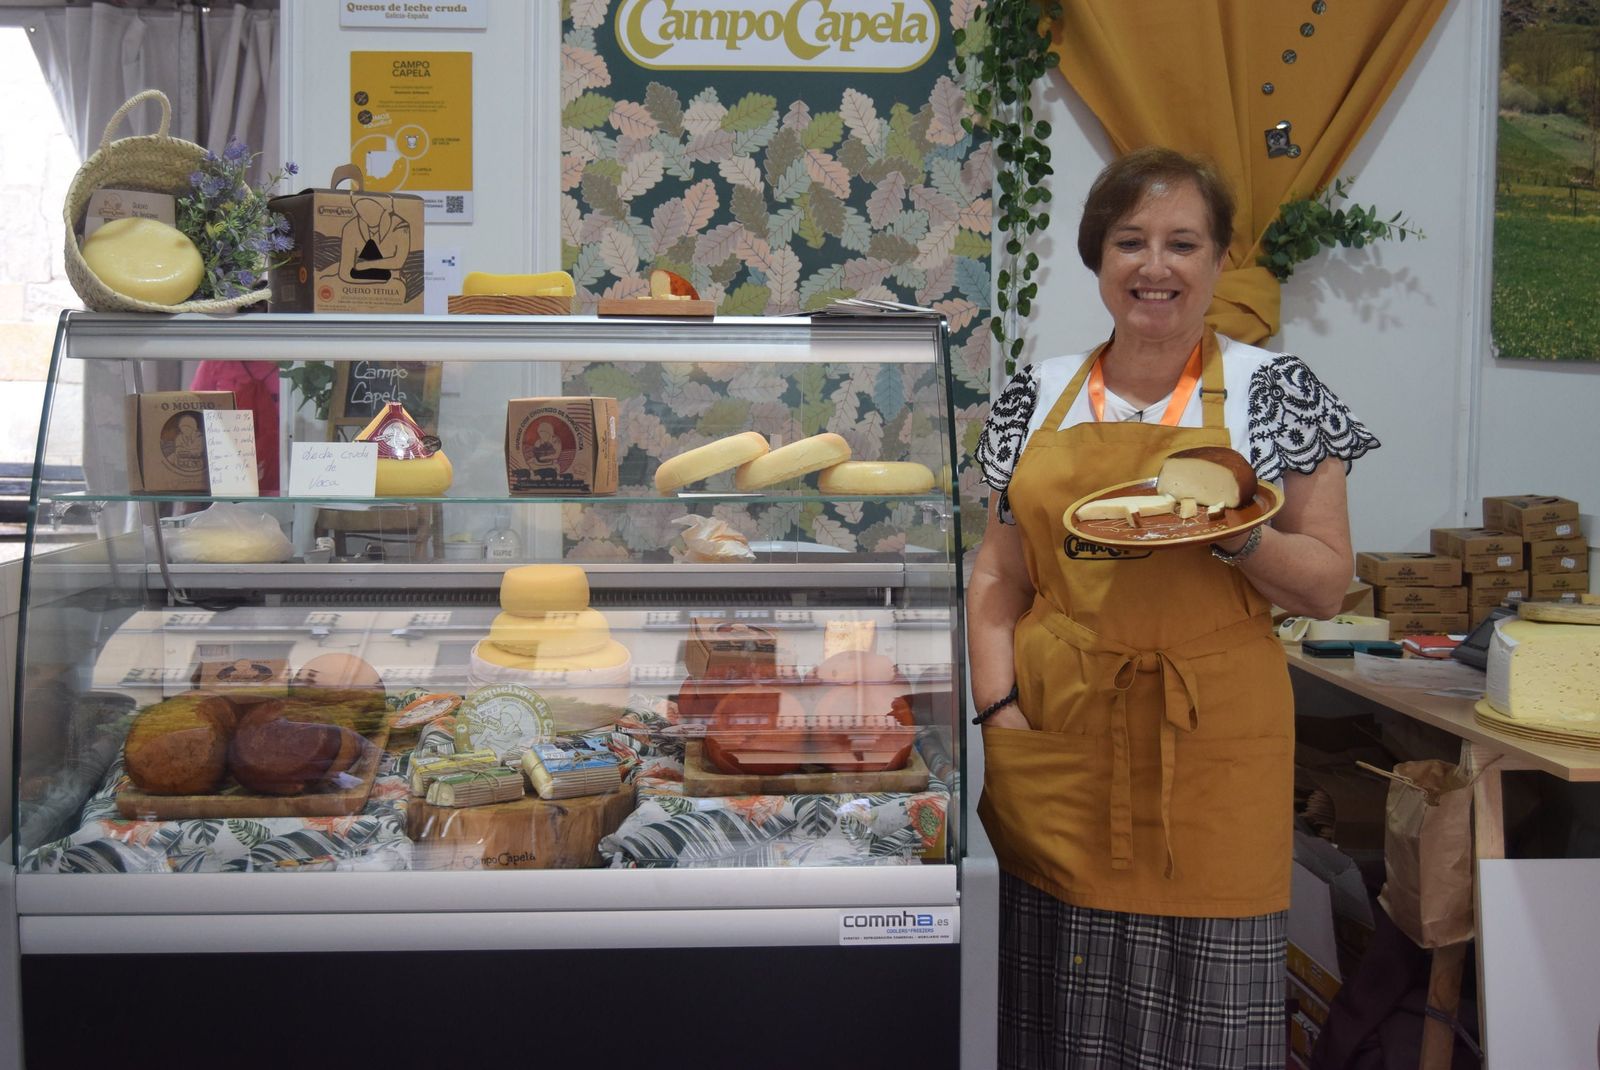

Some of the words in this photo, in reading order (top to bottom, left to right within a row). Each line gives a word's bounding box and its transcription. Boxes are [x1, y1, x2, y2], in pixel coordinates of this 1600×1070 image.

[346, 2, 385, 12] Quesos
[388, 3, 401, 12] de
[404, 3, 433, 12] leche
[435, 4, 468, 12] cruda
[626, 0, 929, 60] CampoCapela
[392, 60, 430, 69] CAMPO
[391, 69, 431, 77] CAPELA
[341, 286, 371, 295] QUEIXO
[373, 288, 400, 296] TETILLA
[354, 360, 409, 386] Campo
[350, 381, 407, 411] Capela
[160, 402, 170, 411] O
[172, 401, 216, 411] MOURO
[843, 910, 949, 928] commha.es
